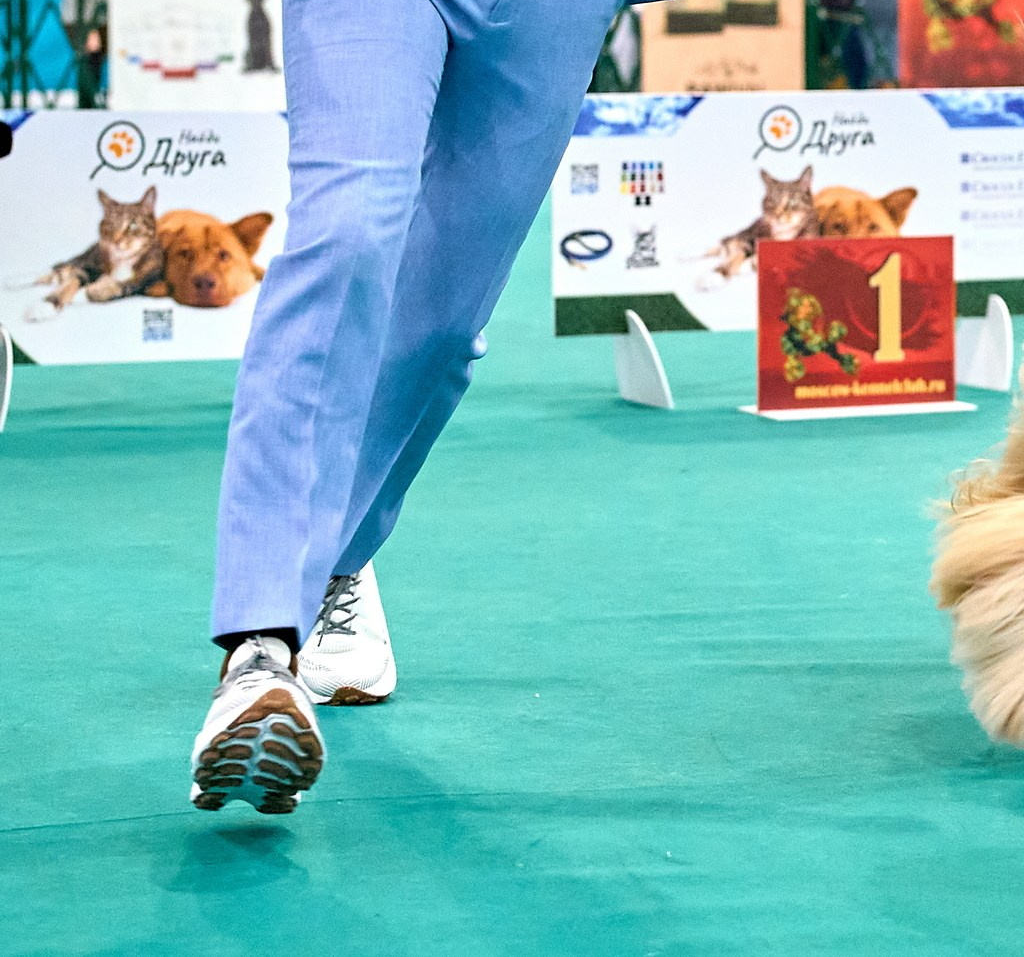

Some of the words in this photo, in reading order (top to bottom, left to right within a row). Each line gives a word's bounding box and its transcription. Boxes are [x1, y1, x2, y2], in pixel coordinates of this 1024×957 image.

[142, 137, 226, 176] Друга
[800, 120, 876, 156] Друга
[868, 251, 905, 363] 1
